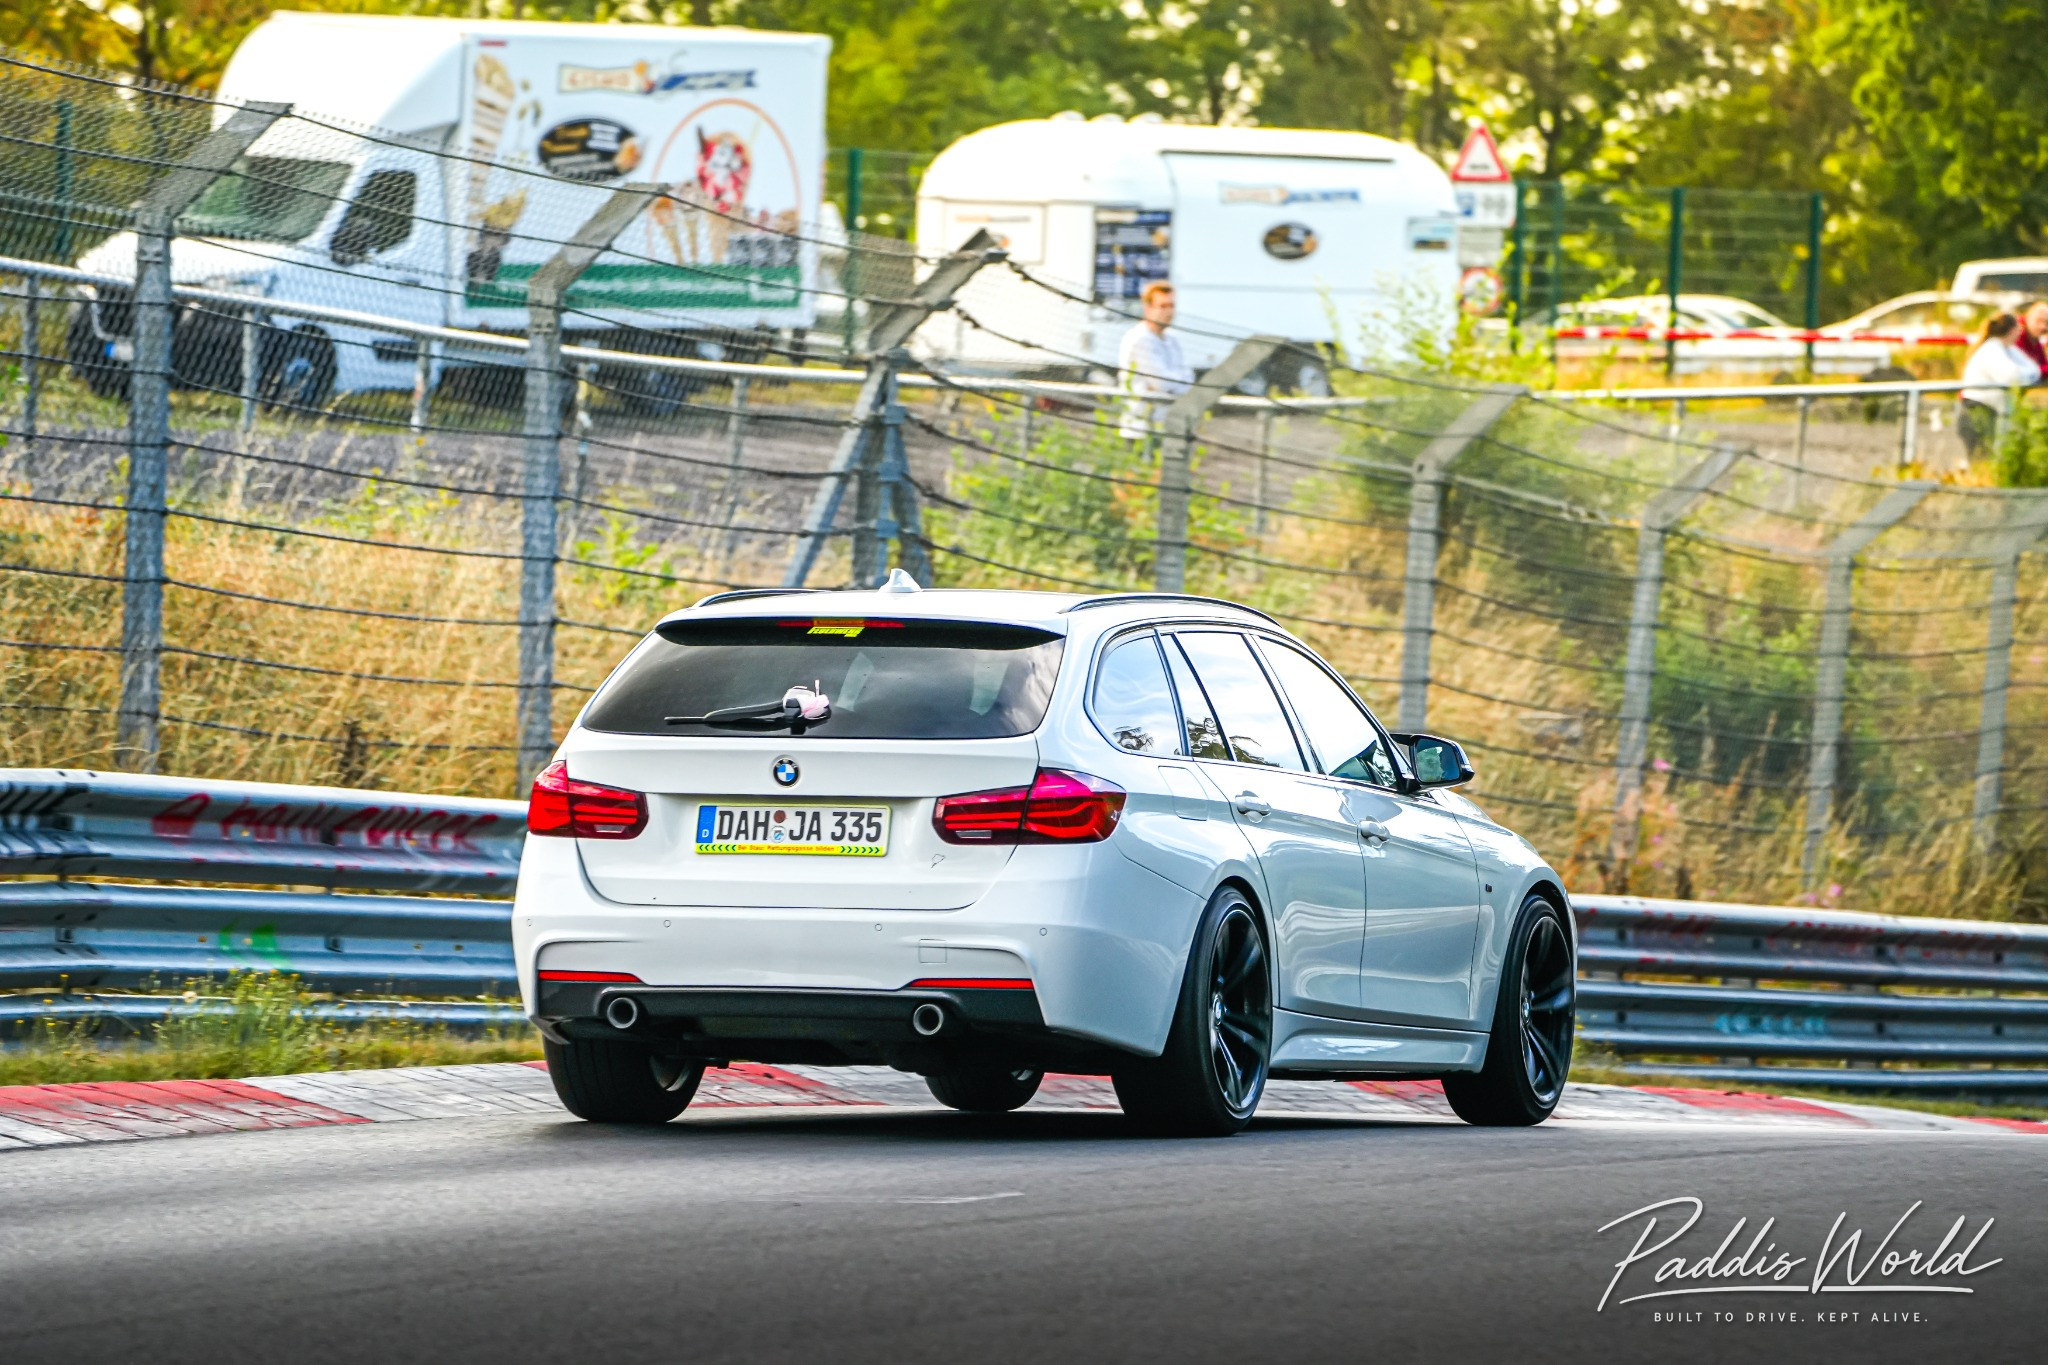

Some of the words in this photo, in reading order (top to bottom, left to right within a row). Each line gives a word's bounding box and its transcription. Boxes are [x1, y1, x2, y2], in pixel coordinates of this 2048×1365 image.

[701, 829, 710, 838] D
[716, 810, 771, 841] DAH
[788, 810, 822, 841] JA
[831, 811, 883, 843] 335
